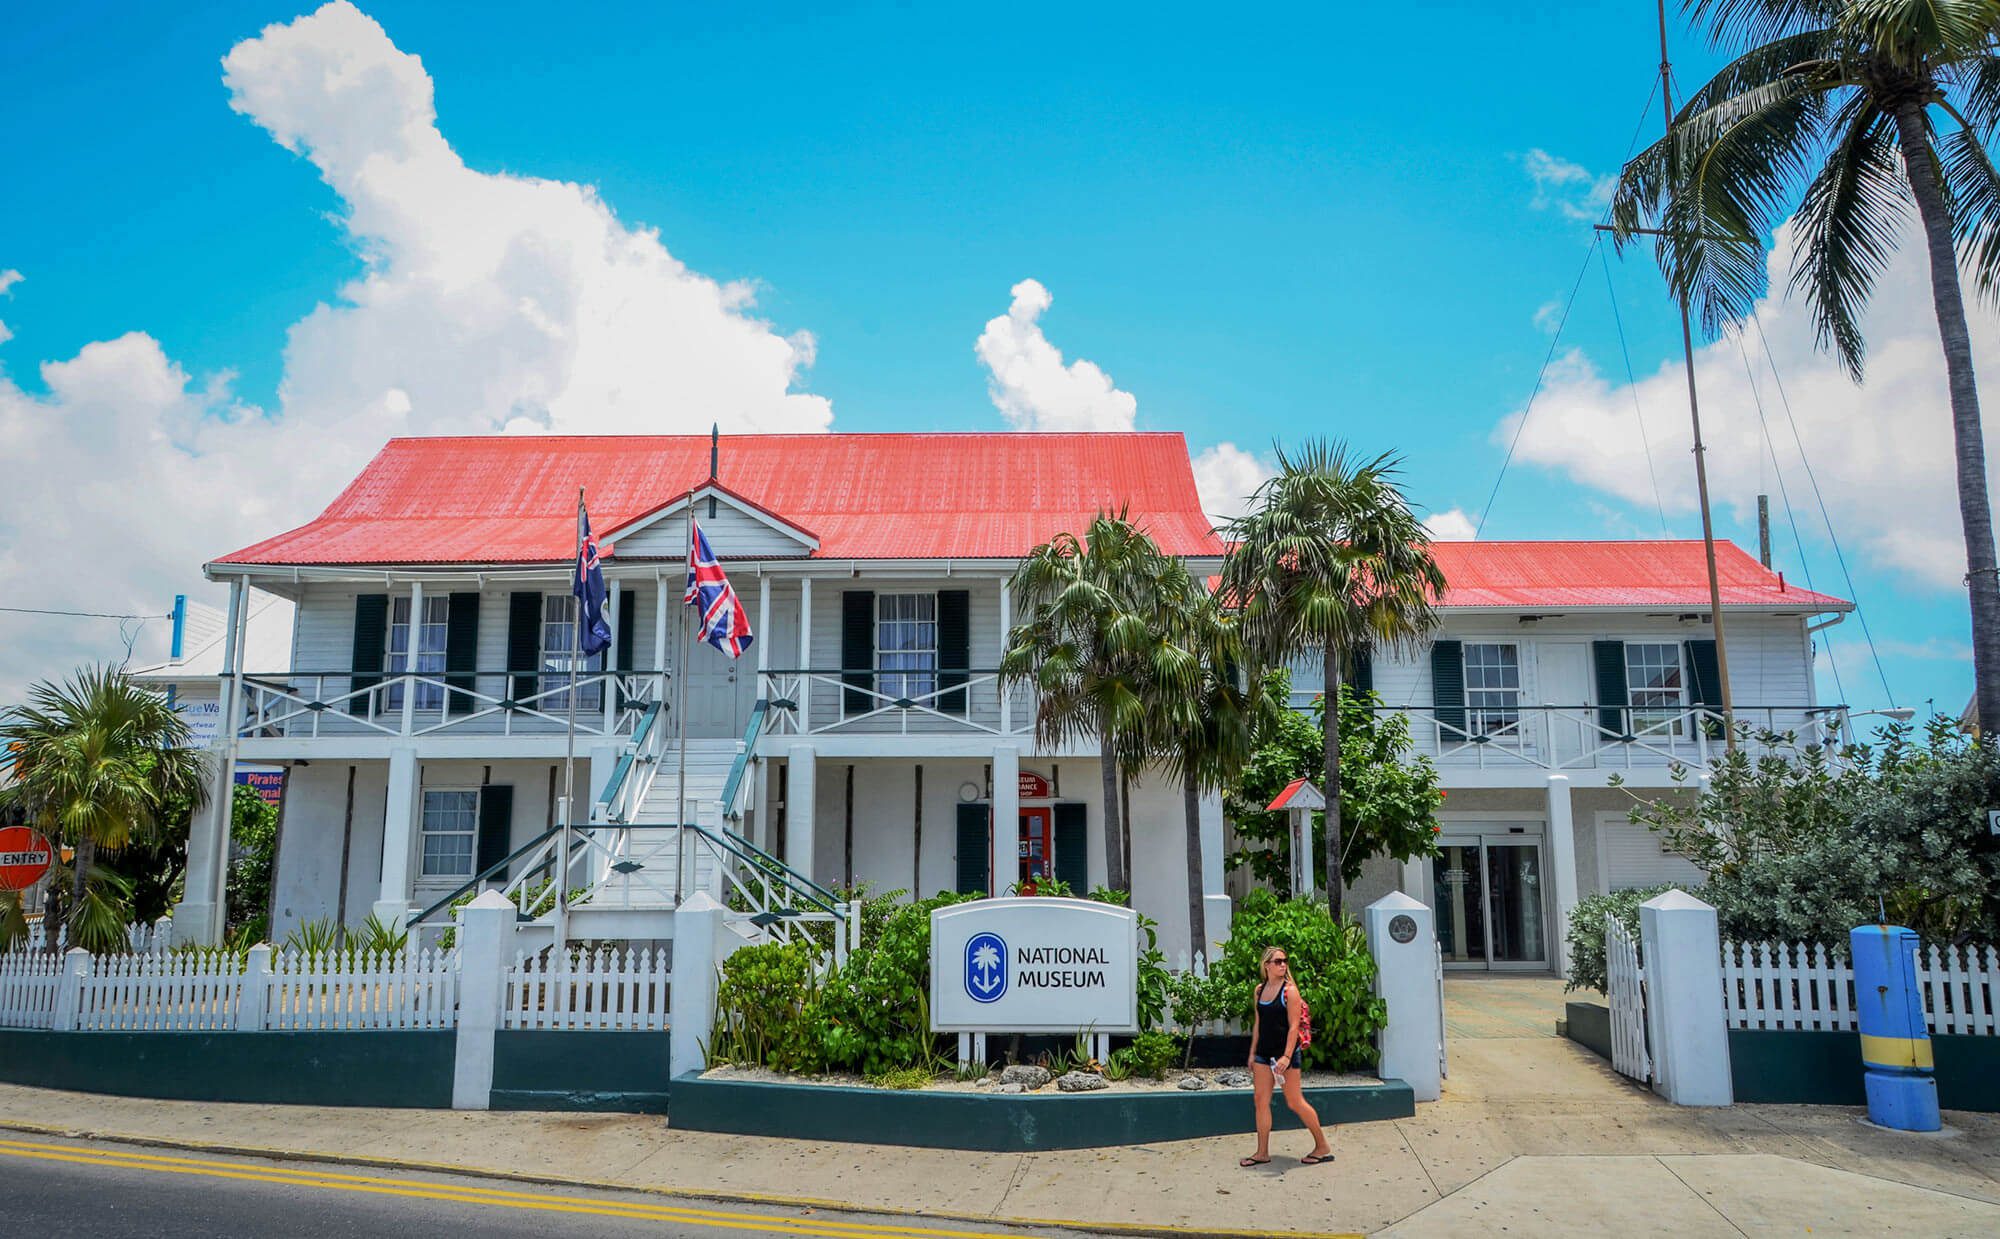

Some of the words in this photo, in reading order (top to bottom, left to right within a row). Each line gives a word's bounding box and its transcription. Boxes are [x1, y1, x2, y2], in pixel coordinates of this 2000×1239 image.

[248, 774, 282, 784] Pirates
[1018, 776, 1037, 784] EUM
[257, 787, 281, 798] onal
[3, 854, 46, 864] ENTRY
[1018, 947, 1110, 965] NATIONAL
[1017, 971, 1106, 988] MUSEUM
